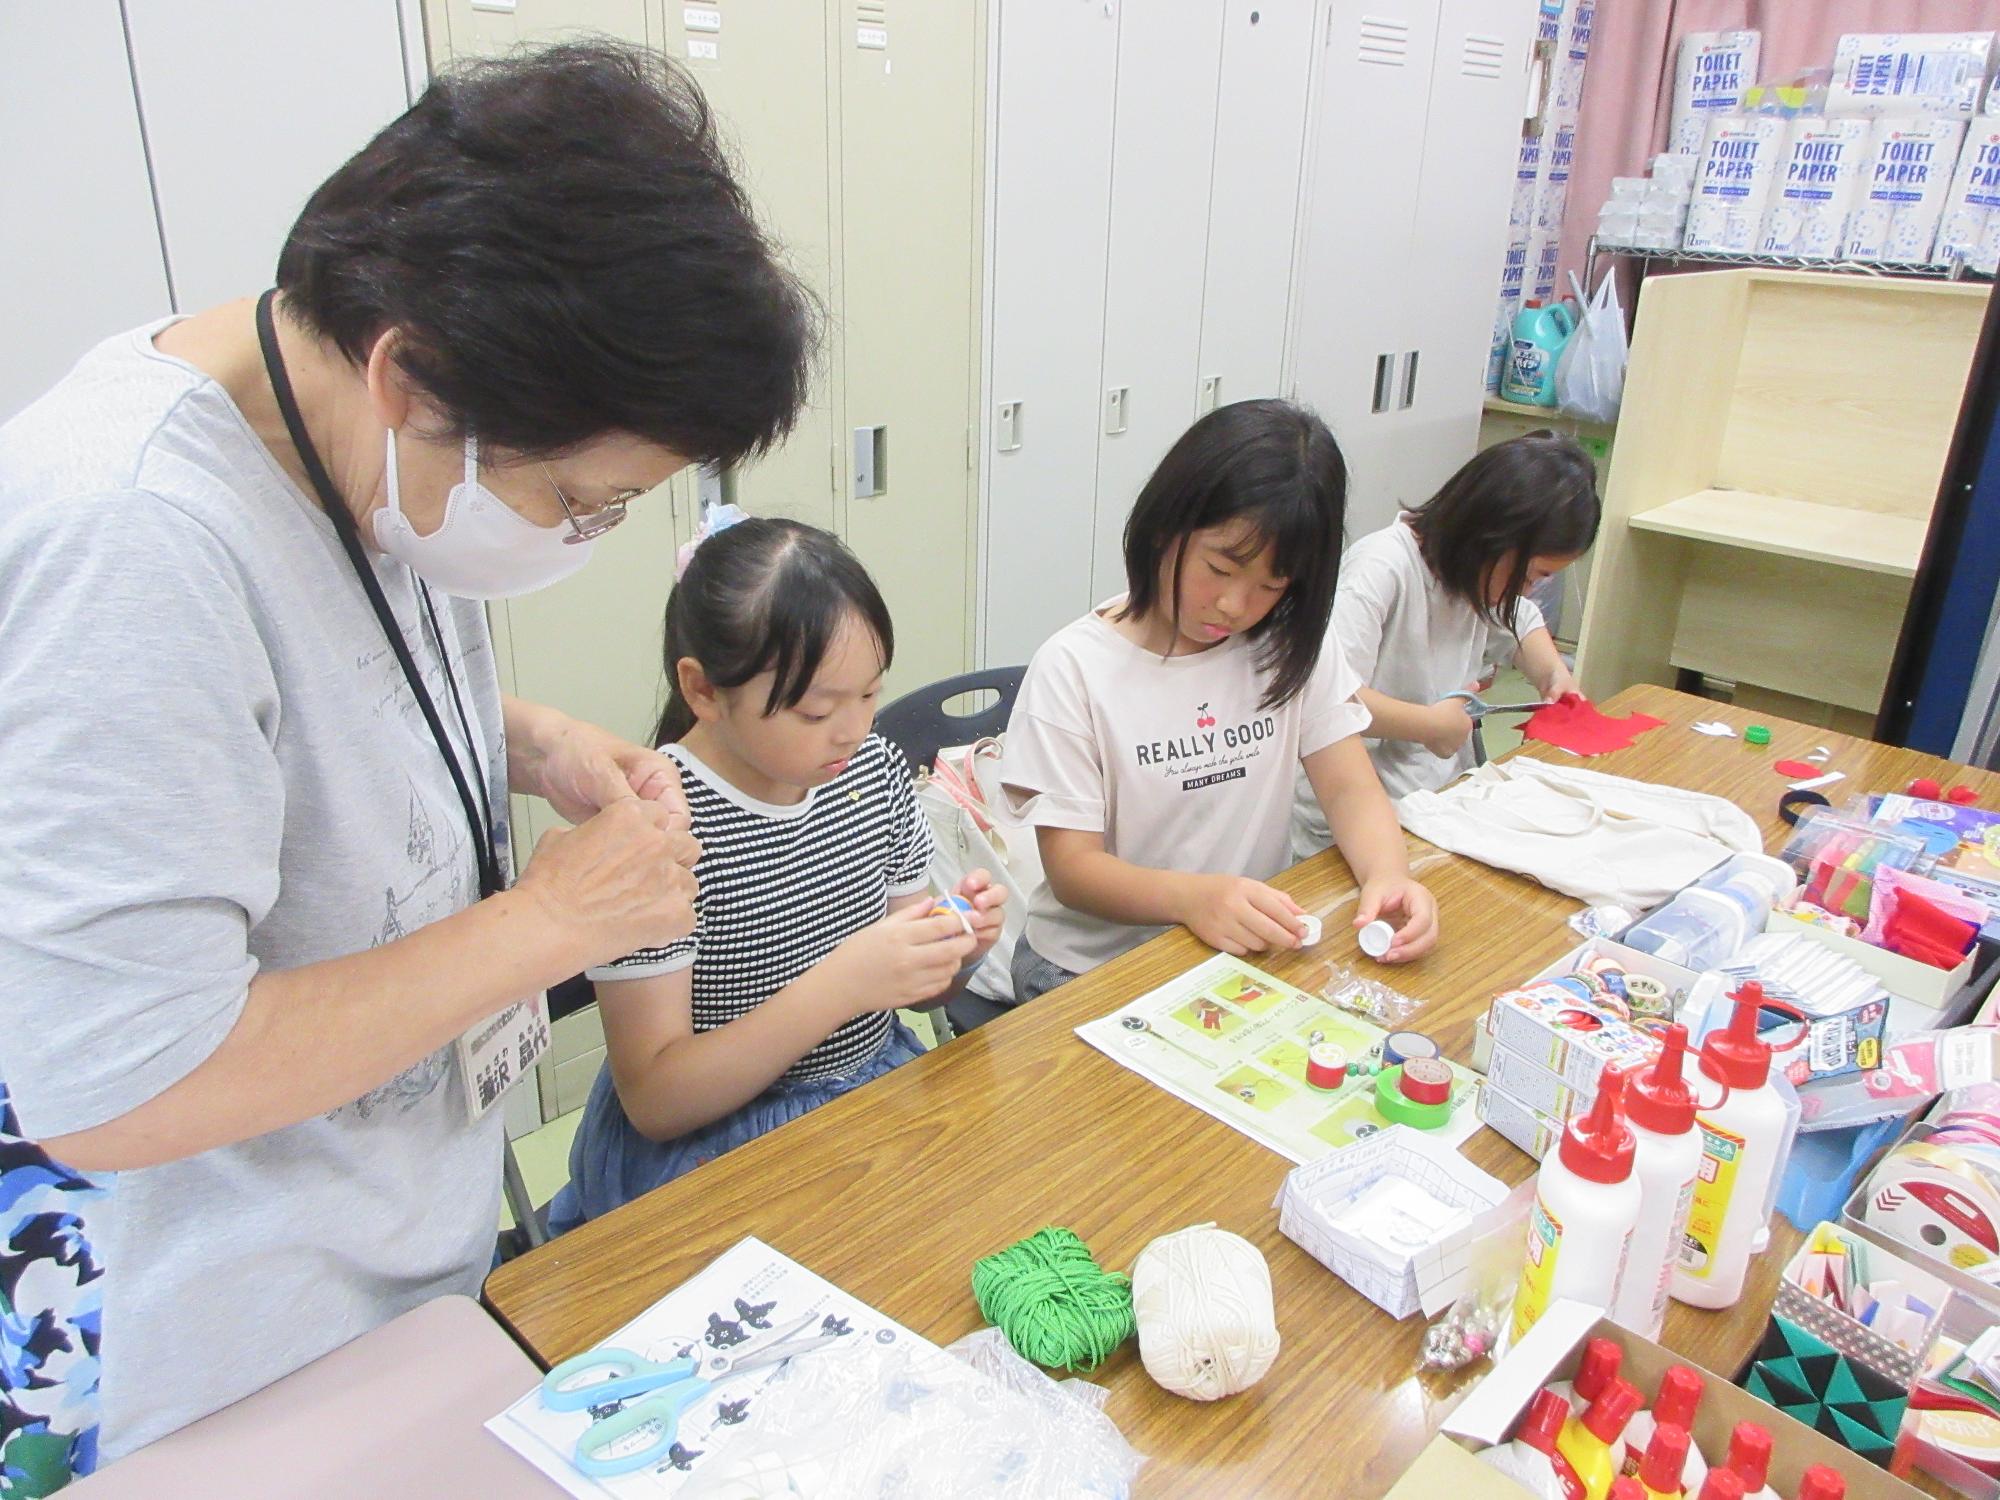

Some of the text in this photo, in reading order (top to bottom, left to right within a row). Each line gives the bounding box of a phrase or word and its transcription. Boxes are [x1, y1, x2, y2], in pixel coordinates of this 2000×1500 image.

[1695, 53, 1741, 73] TOILET
[1692, 73, 1738, 92] PAPER
[1852, 54, 1874, 95] TOILET
[1870, 53, 1894, 96] PAPER
[1711, 140, 1760, 160] TOILET
[1793, 142, 1844, 162] TOILET
[1881, 142, 1935, 162] TOILET
[1705, 160, 1755, 180] PAPER
[1787, 163, 1838, 182] PAPER
[1873, 163, 1928, 183] PAPER
[1506, 249, 1526, 265] TOILET
[1503, 267, 1524, 282] PAPER
[1136, 717, 1274, 766] REALLY GOOD
[1186, 769, 1241, 789] MANY DREAMS
